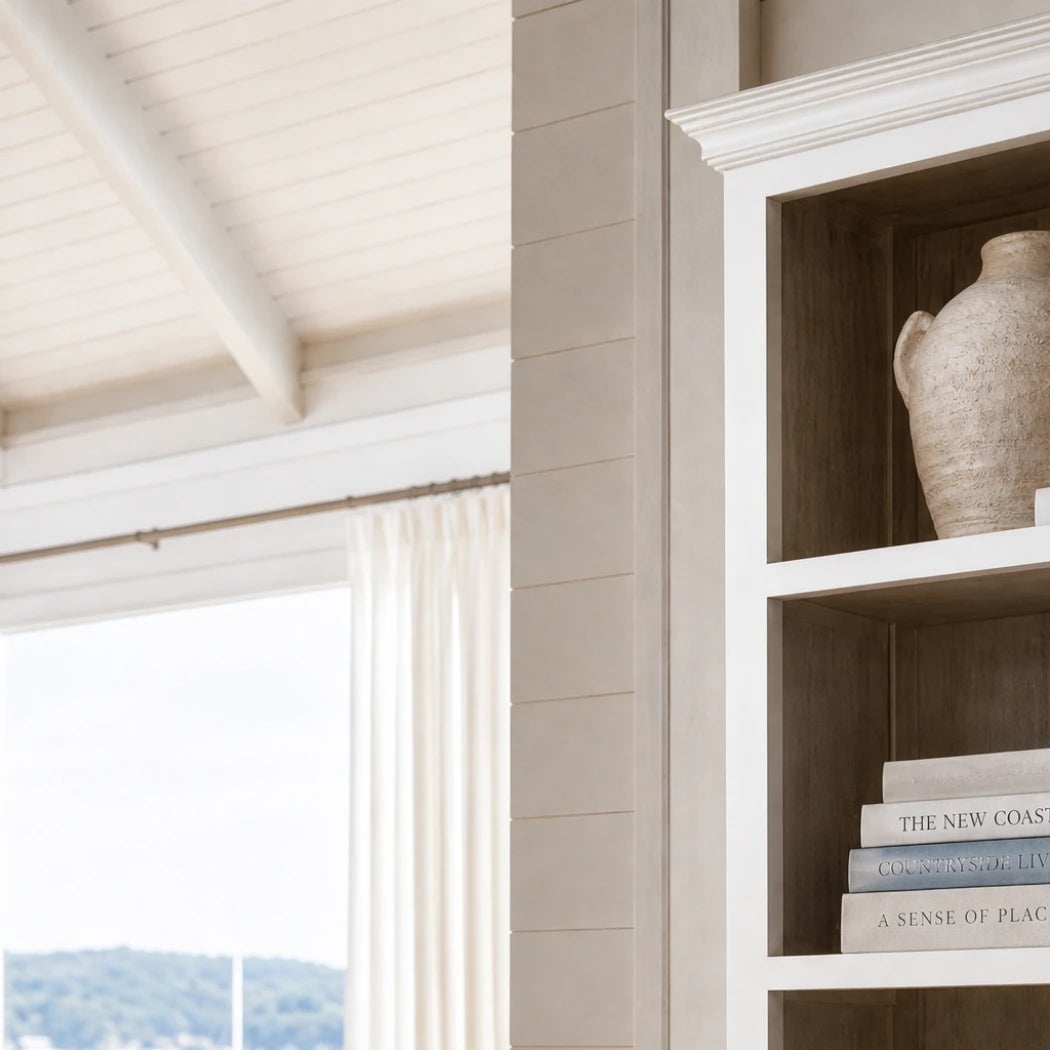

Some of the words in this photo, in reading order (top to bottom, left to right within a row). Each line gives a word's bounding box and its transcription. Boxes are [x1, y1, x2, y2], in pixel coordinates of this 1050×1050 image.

[899, 814, 937, 833] THE
[943, 811, 987, 829] NEW
[878, 854, 1012, 877] COUNTRYSIDE
[878, 912, 890, 928] A
[897, 909, 956, 927] SENSE
[964, 908, 989, 925] OF
